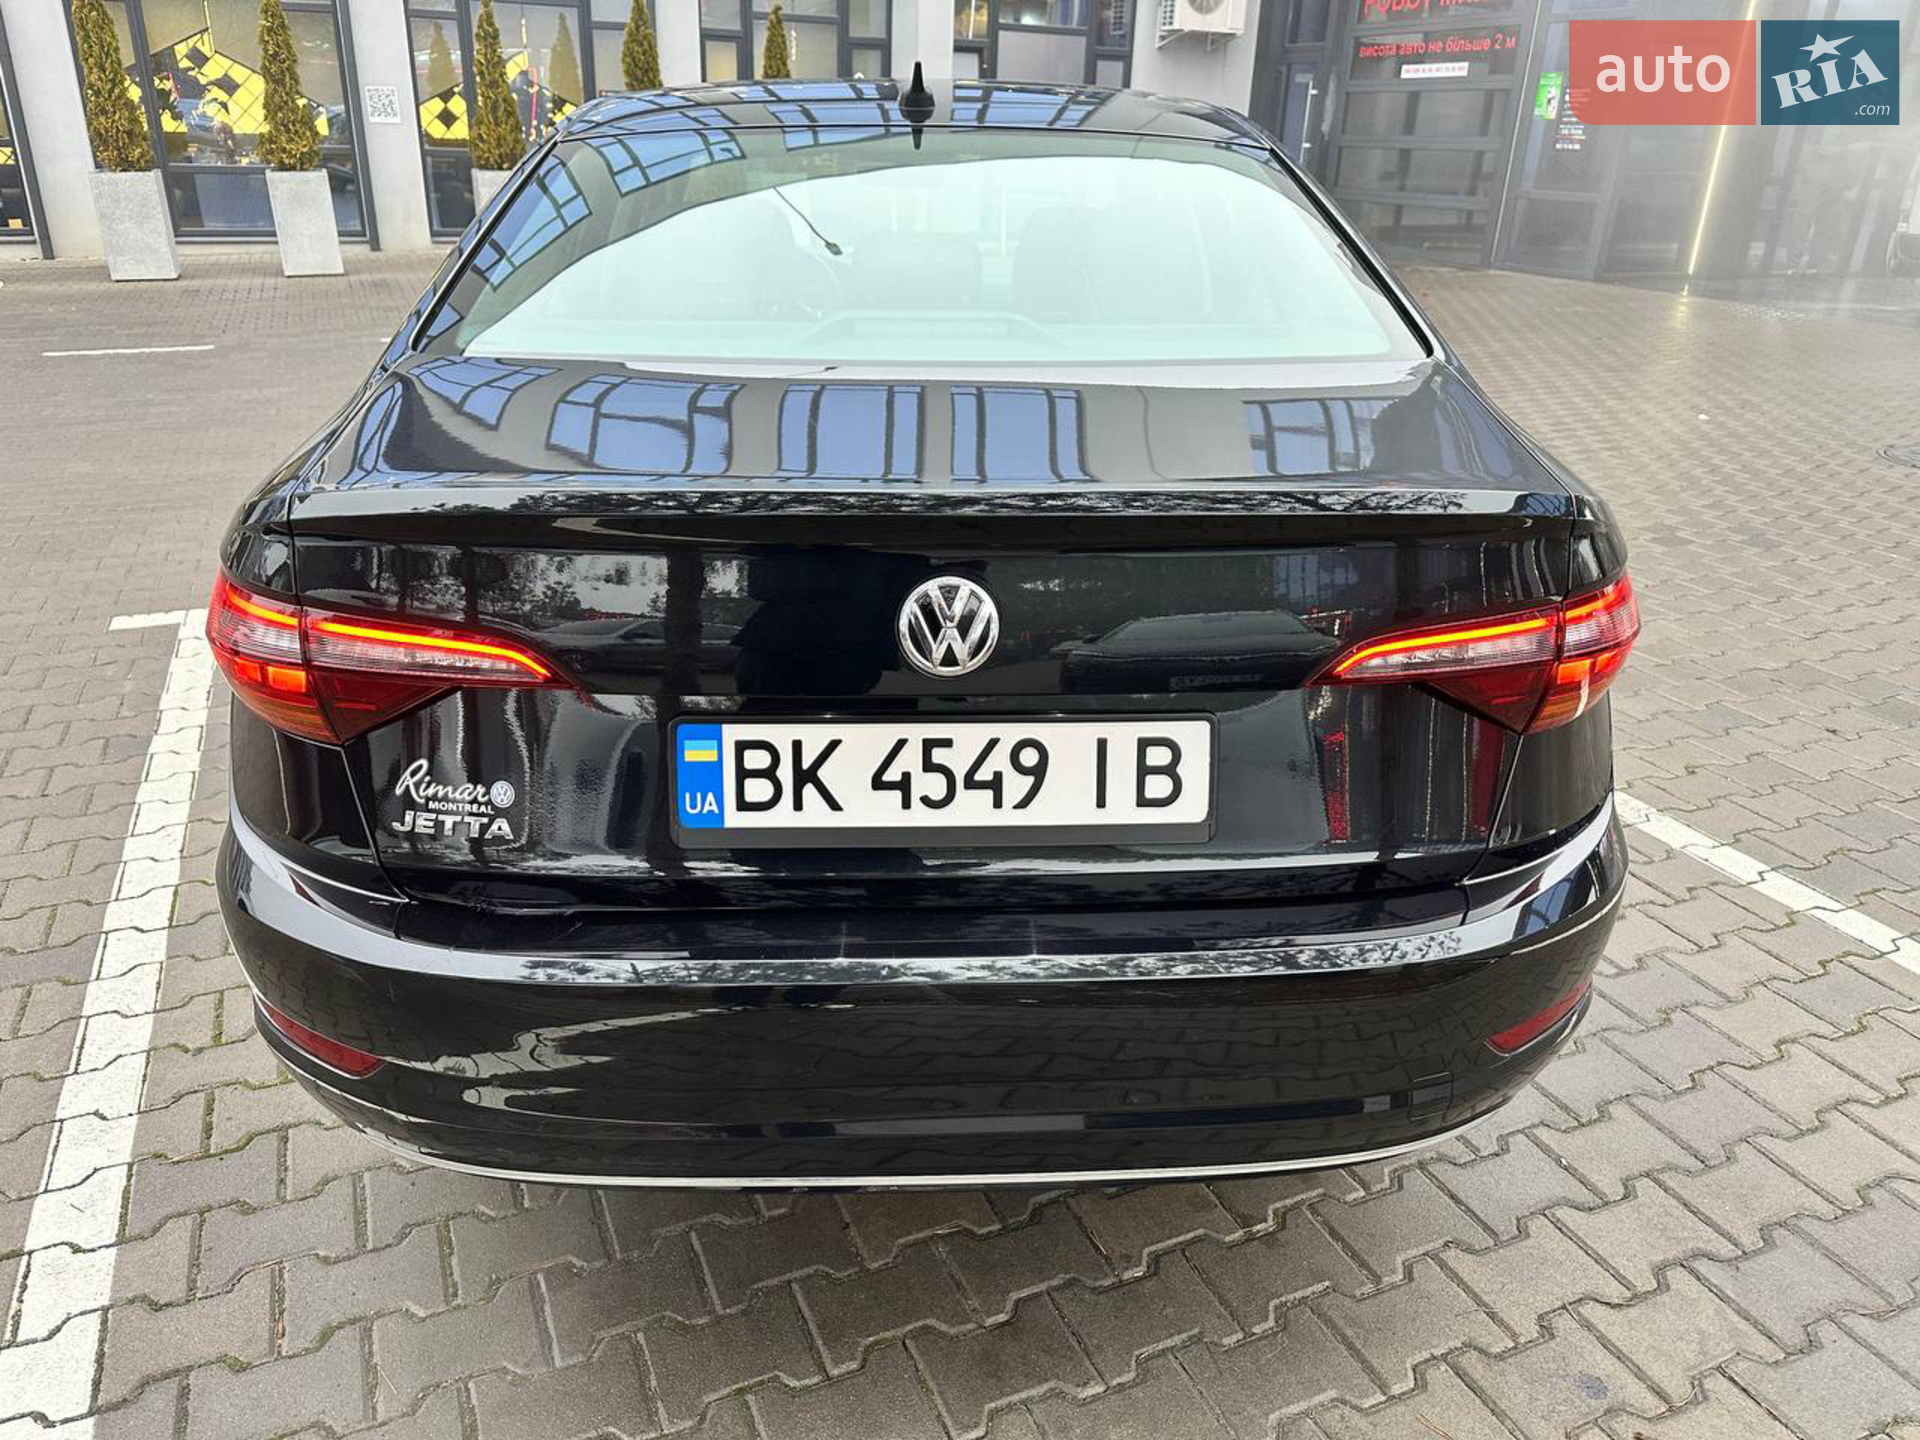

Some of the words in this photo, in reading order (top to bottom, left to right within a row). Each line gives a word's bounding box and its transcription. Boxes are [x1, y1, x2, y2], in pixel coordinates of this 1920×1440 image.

[1399, 41, 1426, 55] авто
[1428, 40, 1442, 53] не
[1446, 36, 1491, 53] більше
[1494, 33, 1503, 49] 2
[395, 758, 490, 804] Rimar
[733, 737, 844, 813] BK
[870, 736, 1050, 811] 4549
[1096, 736, 1183, 809] IB
[428, 800, 495, 814] MONTREAL
[685, 792, 720, 815] UA
[391, 810, 514, 839] JETTA
